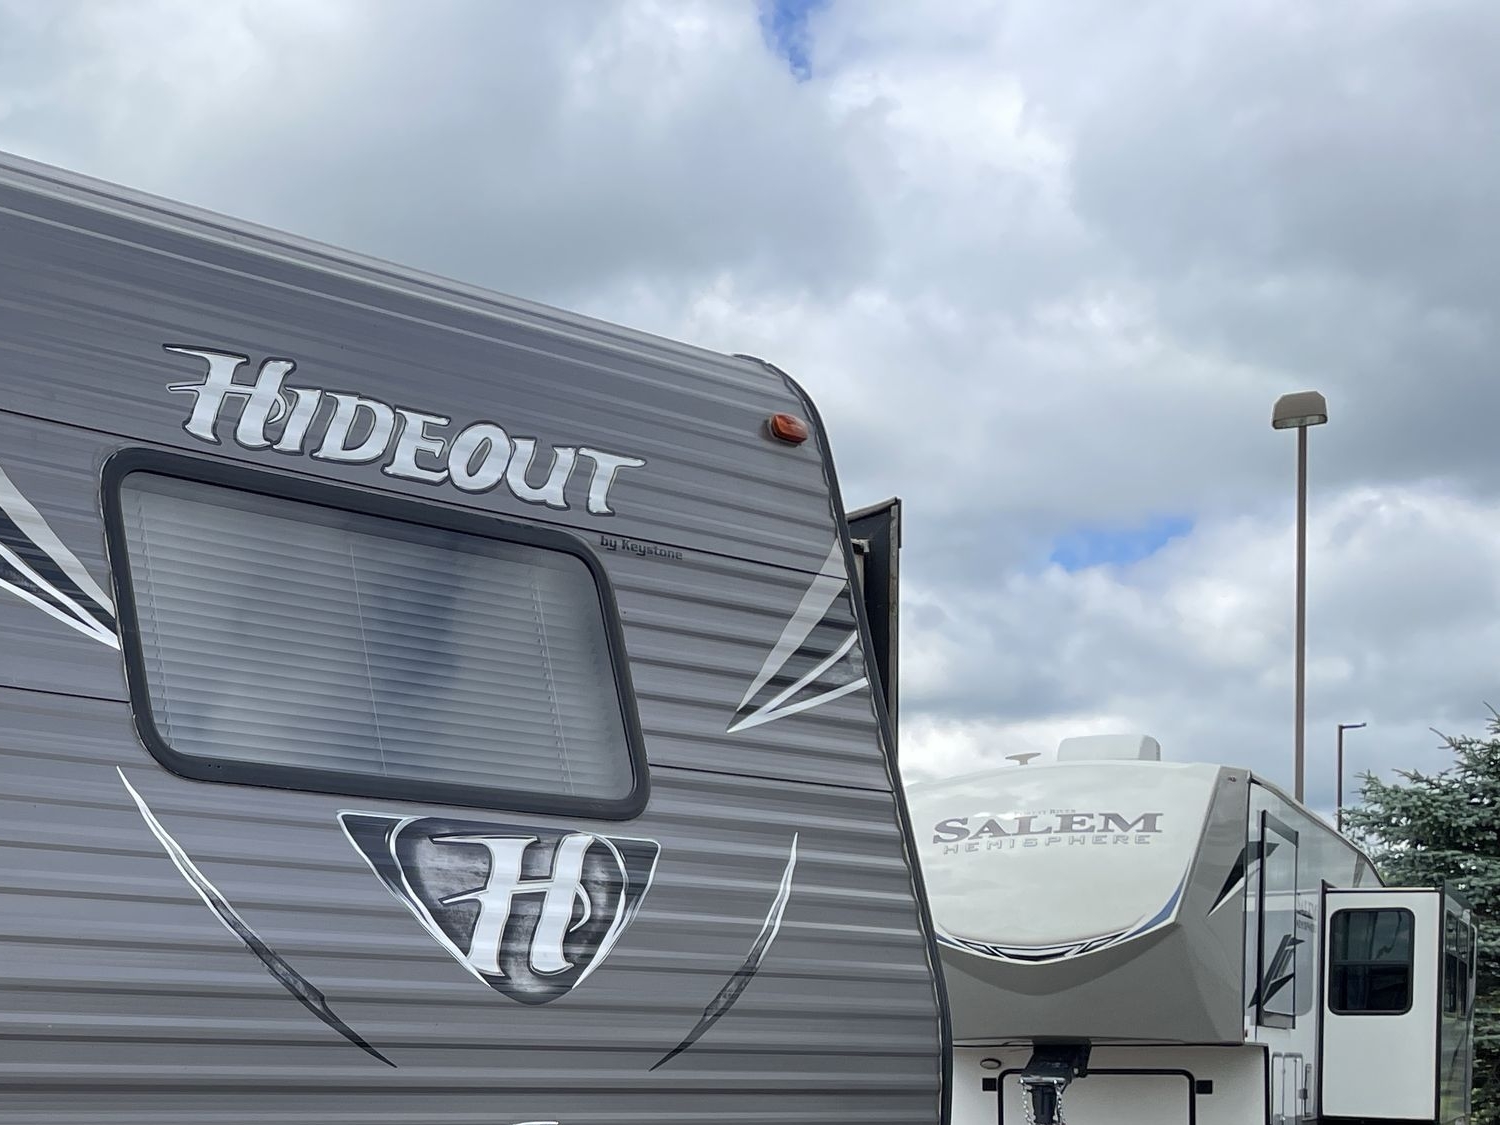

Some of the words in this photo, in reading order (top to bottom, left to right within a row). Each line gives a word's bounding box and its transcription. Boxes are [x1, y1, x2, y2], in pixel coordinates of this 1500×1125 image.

[162, 344, 647, 516] HIDEOUT
[600, 535, 617, 551] by
[621, 538, 683, 560] Keystone
[932, 812, 1164, 844] SALEM
[942, 834, 1152, 855] HEMISPHERE
